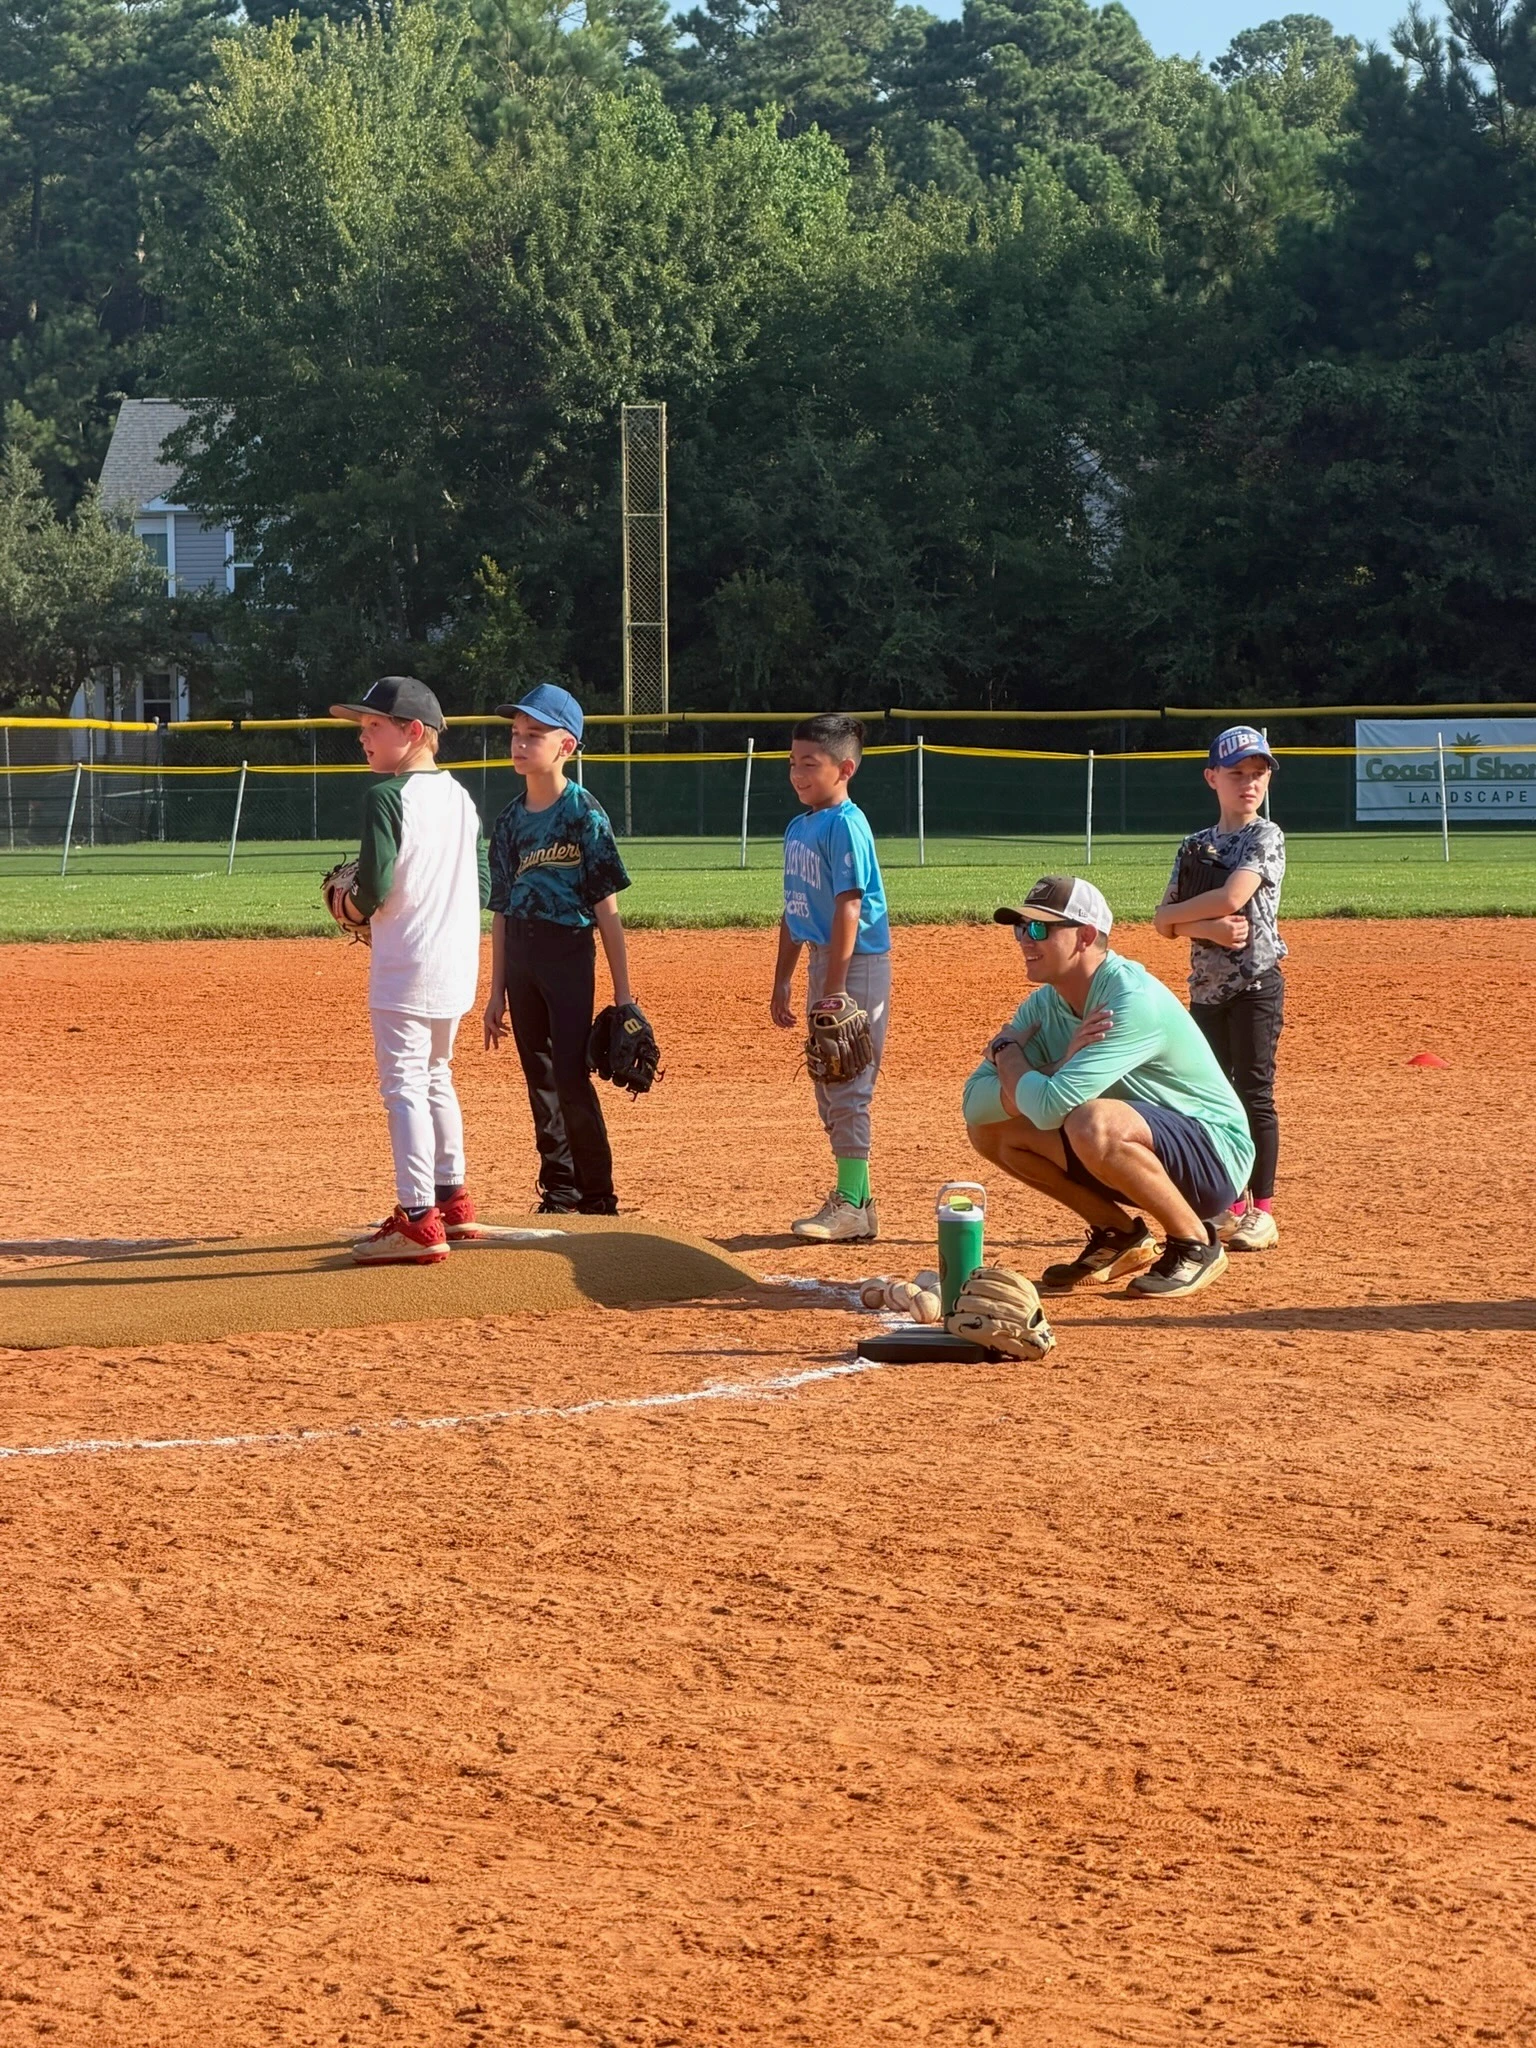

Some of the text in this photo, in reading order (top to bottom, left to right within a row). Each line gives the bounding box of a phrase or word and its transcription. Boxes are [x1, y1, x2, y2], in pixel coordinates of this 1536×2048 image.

[1219, 734, 1259, 758] CUBS
[1365, 757, 1471, 780] Coastal
[1408, 790, 1528, 804] LANDSCAPE
